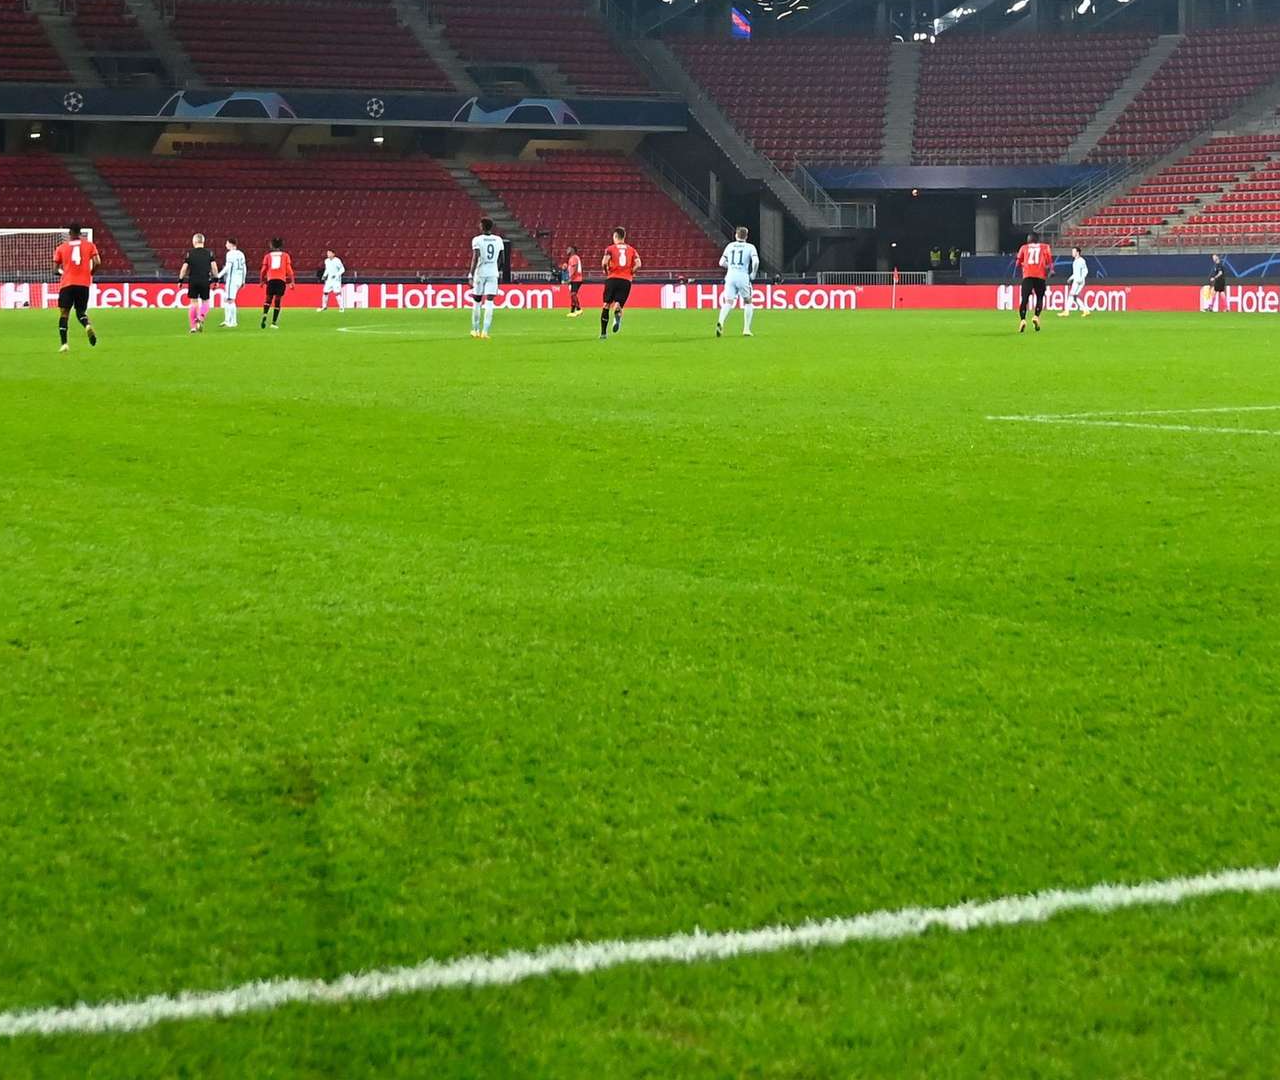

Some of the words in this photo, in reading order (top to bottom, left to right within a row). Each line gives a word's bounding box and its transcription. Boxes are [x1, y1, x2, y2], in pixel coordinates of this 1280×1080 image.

[487, 243, 495, 261] 9
[730, 249, 744, 267] 11
[381, 283, 554, 309] Hotelscom
